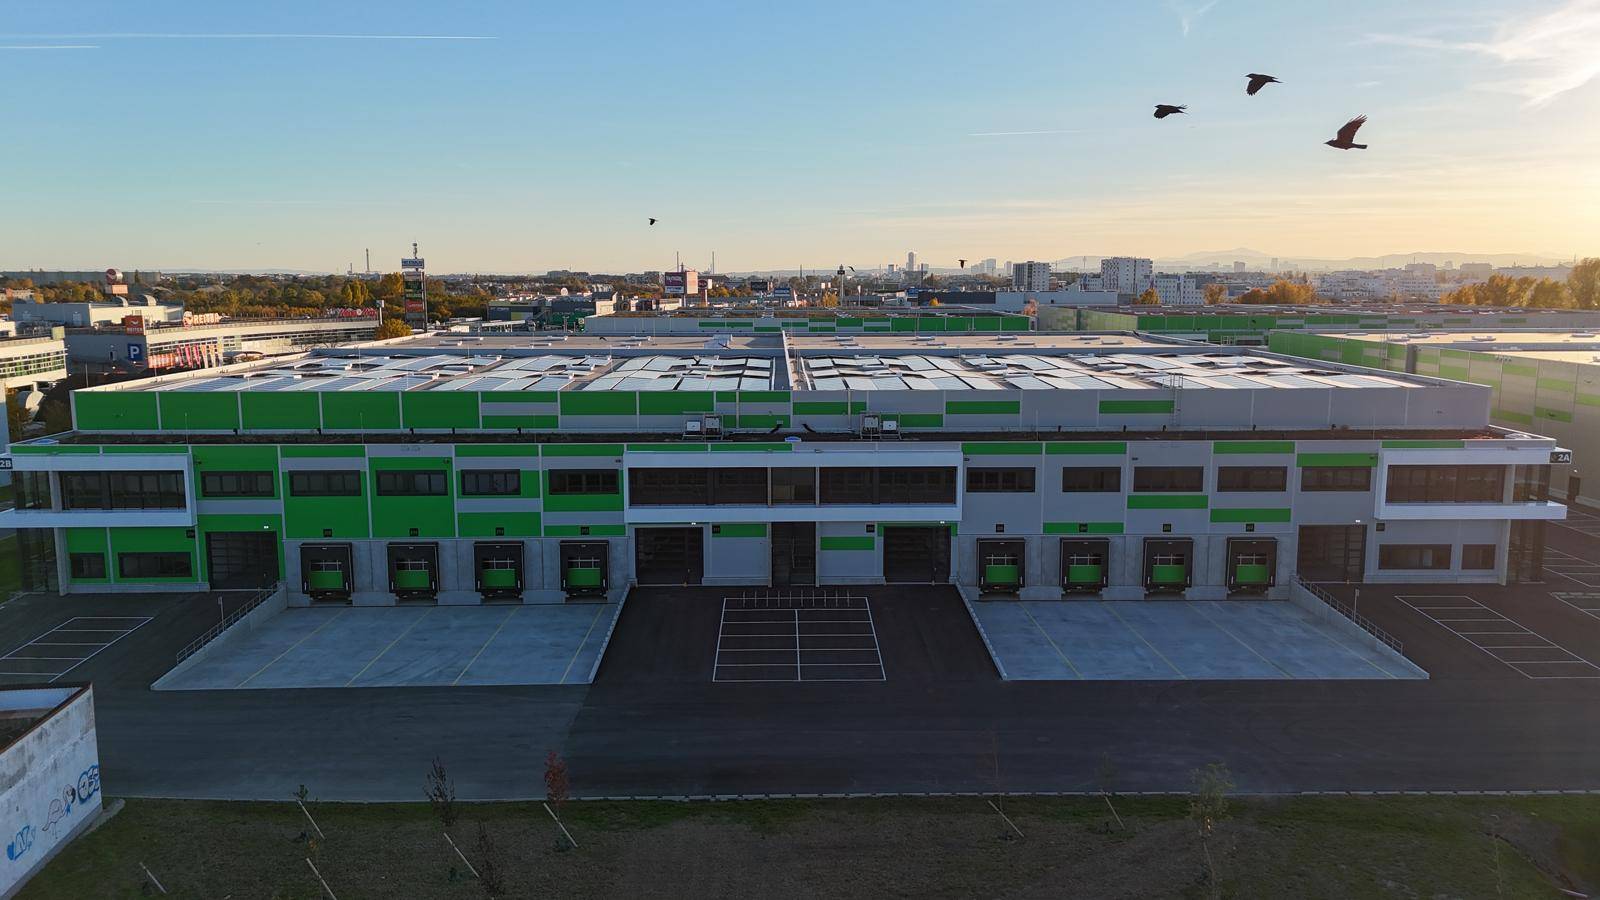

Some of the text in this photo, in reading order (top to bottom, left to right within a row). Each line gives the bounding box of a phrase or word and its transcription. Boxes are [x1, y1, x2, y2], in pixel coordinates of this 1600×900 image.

[130, 345, 140, 359] P
[1558, 453, 1570, 462] 2A
[0, 459, 12, 468] 2B
